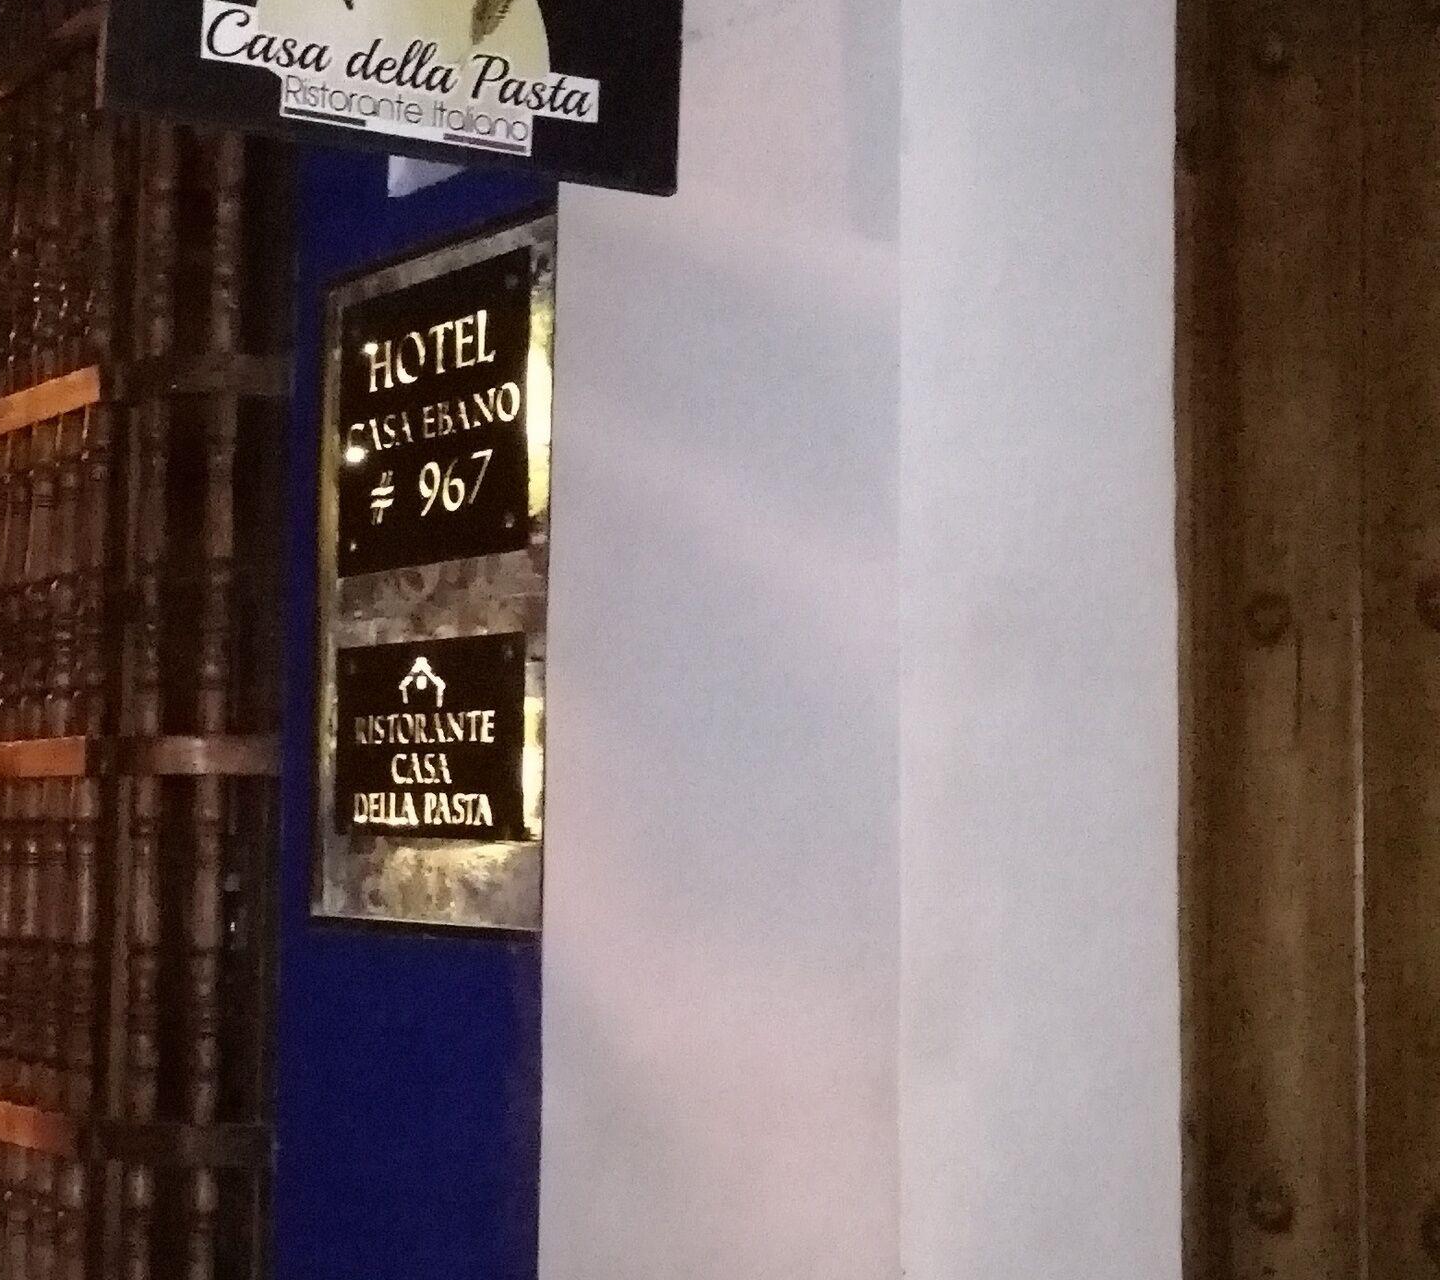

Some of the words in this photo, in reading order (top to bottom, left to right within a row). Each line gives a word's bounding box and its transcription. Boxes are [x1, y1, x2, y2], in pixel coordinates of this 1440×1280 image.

[206, 9, 332, 73] Casa
[345, 38, 456, 94] della
[472, 53, 593, 117] Pasta
[285, 76, 422, 124] Ristorante
[433, 100, 529, 141] Italiano
[364, 309, 496, 392] HOTEL
[419, 448, 494, 517] 967
[355, 710, 495, 744] RISTORANTE
[392, 753, 452, 784] CASA
[353, 793, 420, 826] DELLA
[423, 793, 494, 826] PASTA
